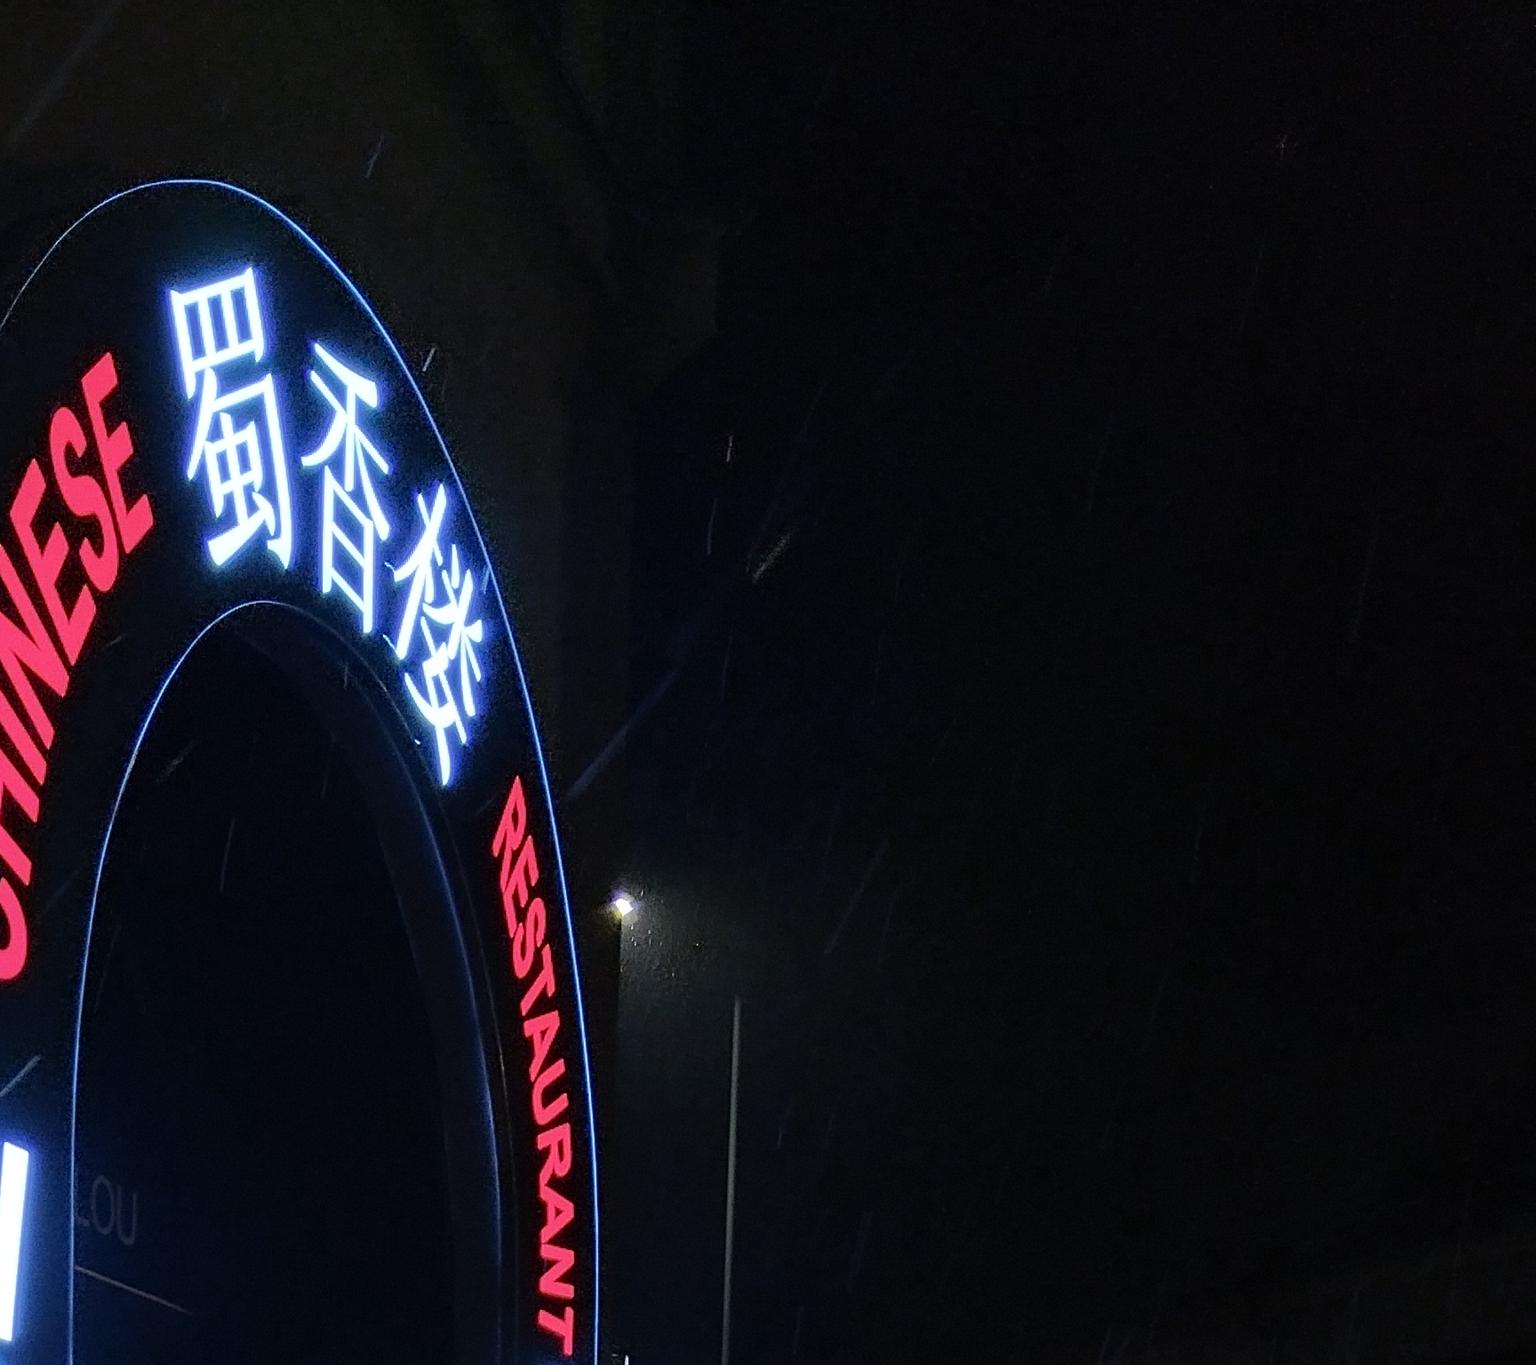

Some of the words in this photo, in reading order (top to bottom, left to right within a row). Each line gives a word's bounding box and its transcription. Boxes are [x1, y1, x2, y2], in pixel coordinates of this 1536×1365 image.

[168, 266, 484, 786] 蜀香楼
[492, 775, 576, 1357] RESTAURANT
